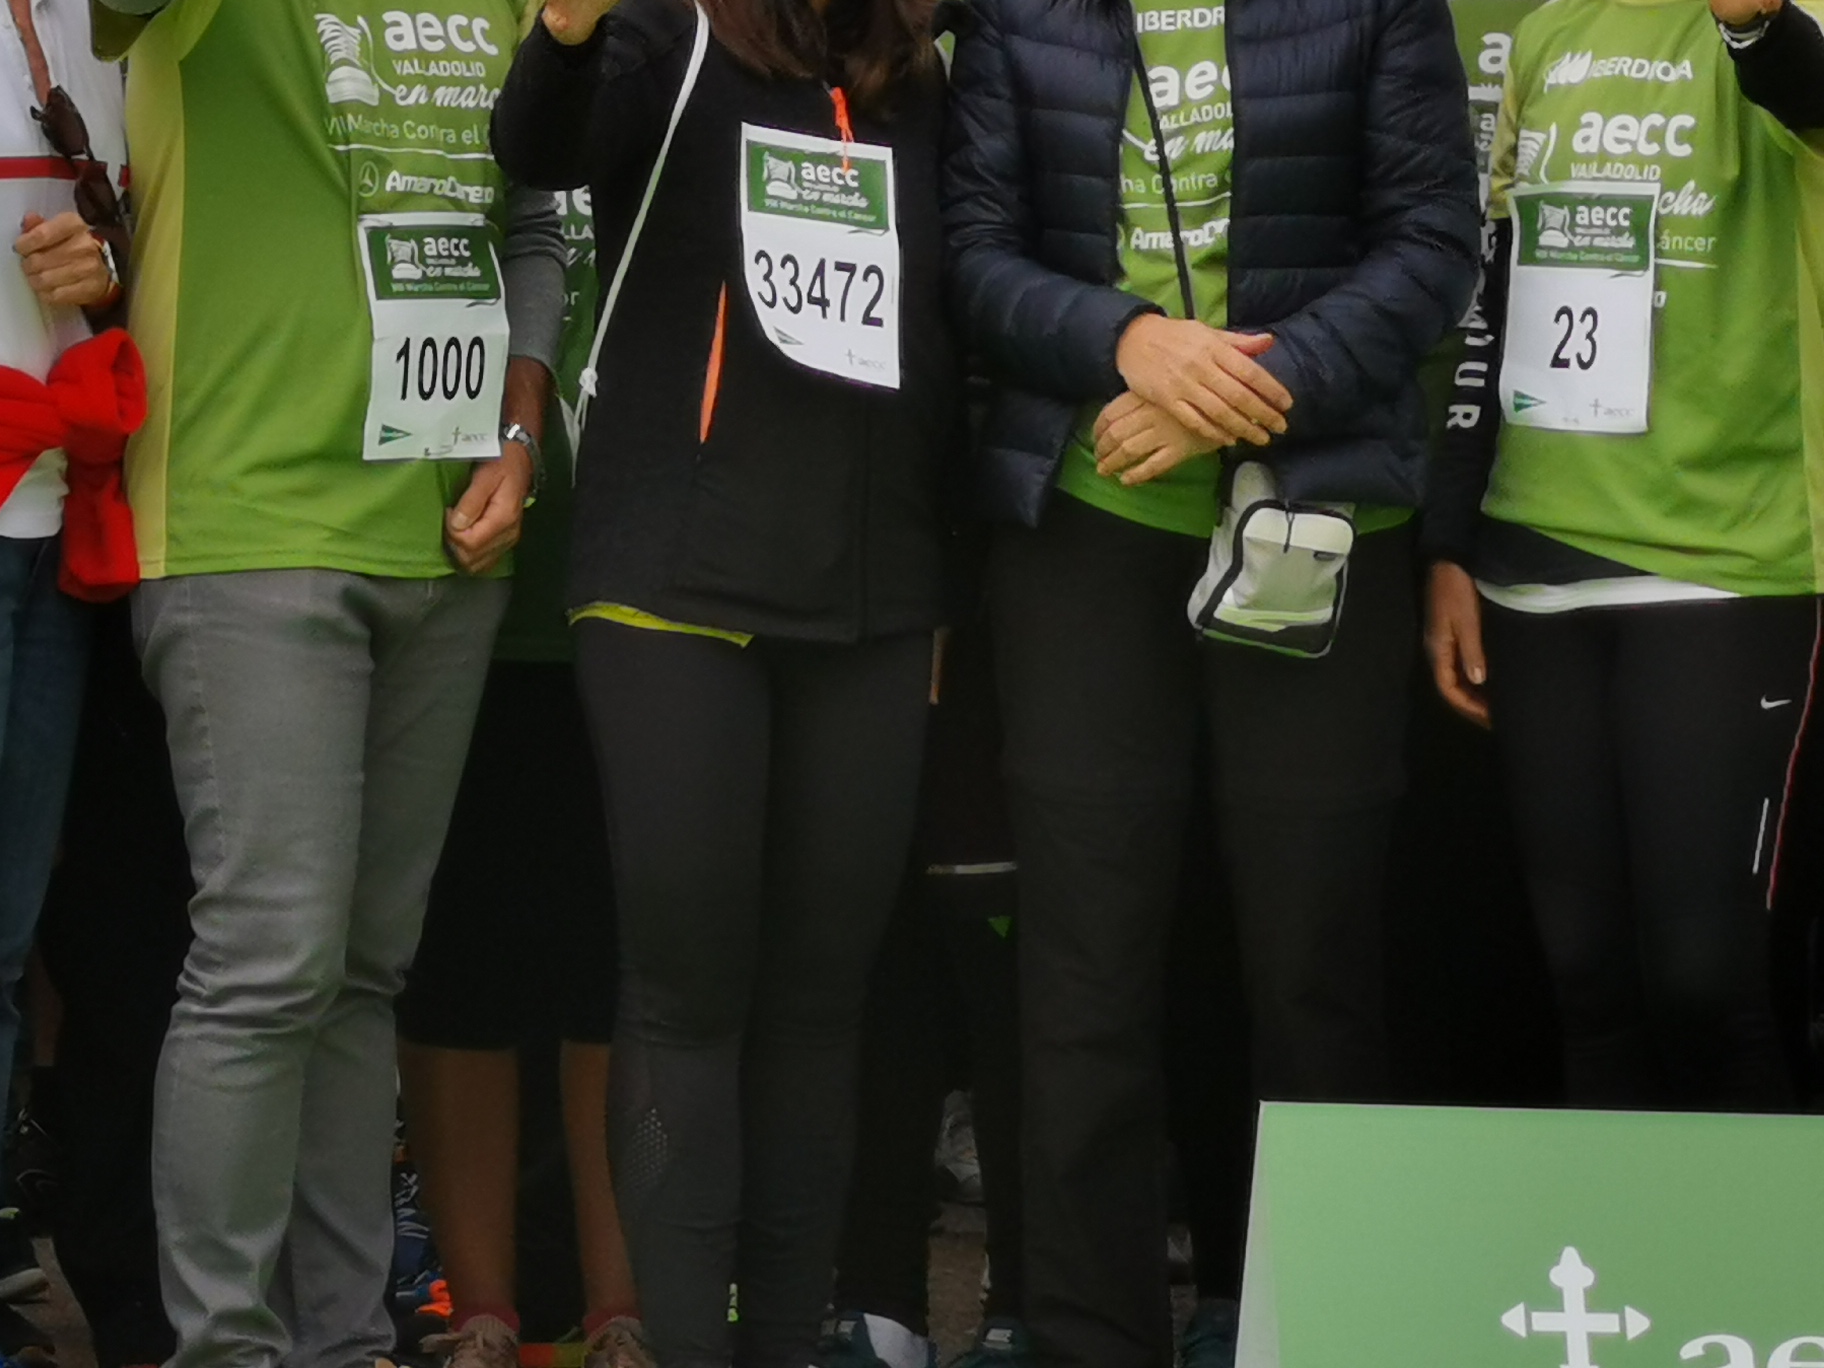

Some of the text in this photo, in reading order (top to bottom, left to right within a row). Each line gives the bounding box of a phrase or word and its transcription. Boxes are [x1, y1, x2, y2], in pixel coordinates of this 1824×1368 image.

[382, 10, 499, 55] aecc
[1136, 6, 1225, 33] IBERDR
[392, 59, 486, 78] VALADOLID
[433, 84, 501, 110] marc
[1148, 59, 1231, 109] ae
[462, 124, 481, 145] el
[1572, 111, 1696, 157] aecc
[800, 161, 860, 187] aecc
[1151, 172, 1218, 194] Cntra
[1570, 161, 1661, 181] VALADOLID
[1657, 180, 1717, 217] cha
[1575, 204, 1632, 227] aecc
[423, 236, 472, 257] aecc
[1657, 229, 1716, 252] áncer
[754, 249, 885, 328] 33472
[1549, 305, 1598, 371] 23
[395, 335, 486, 401] 1000
